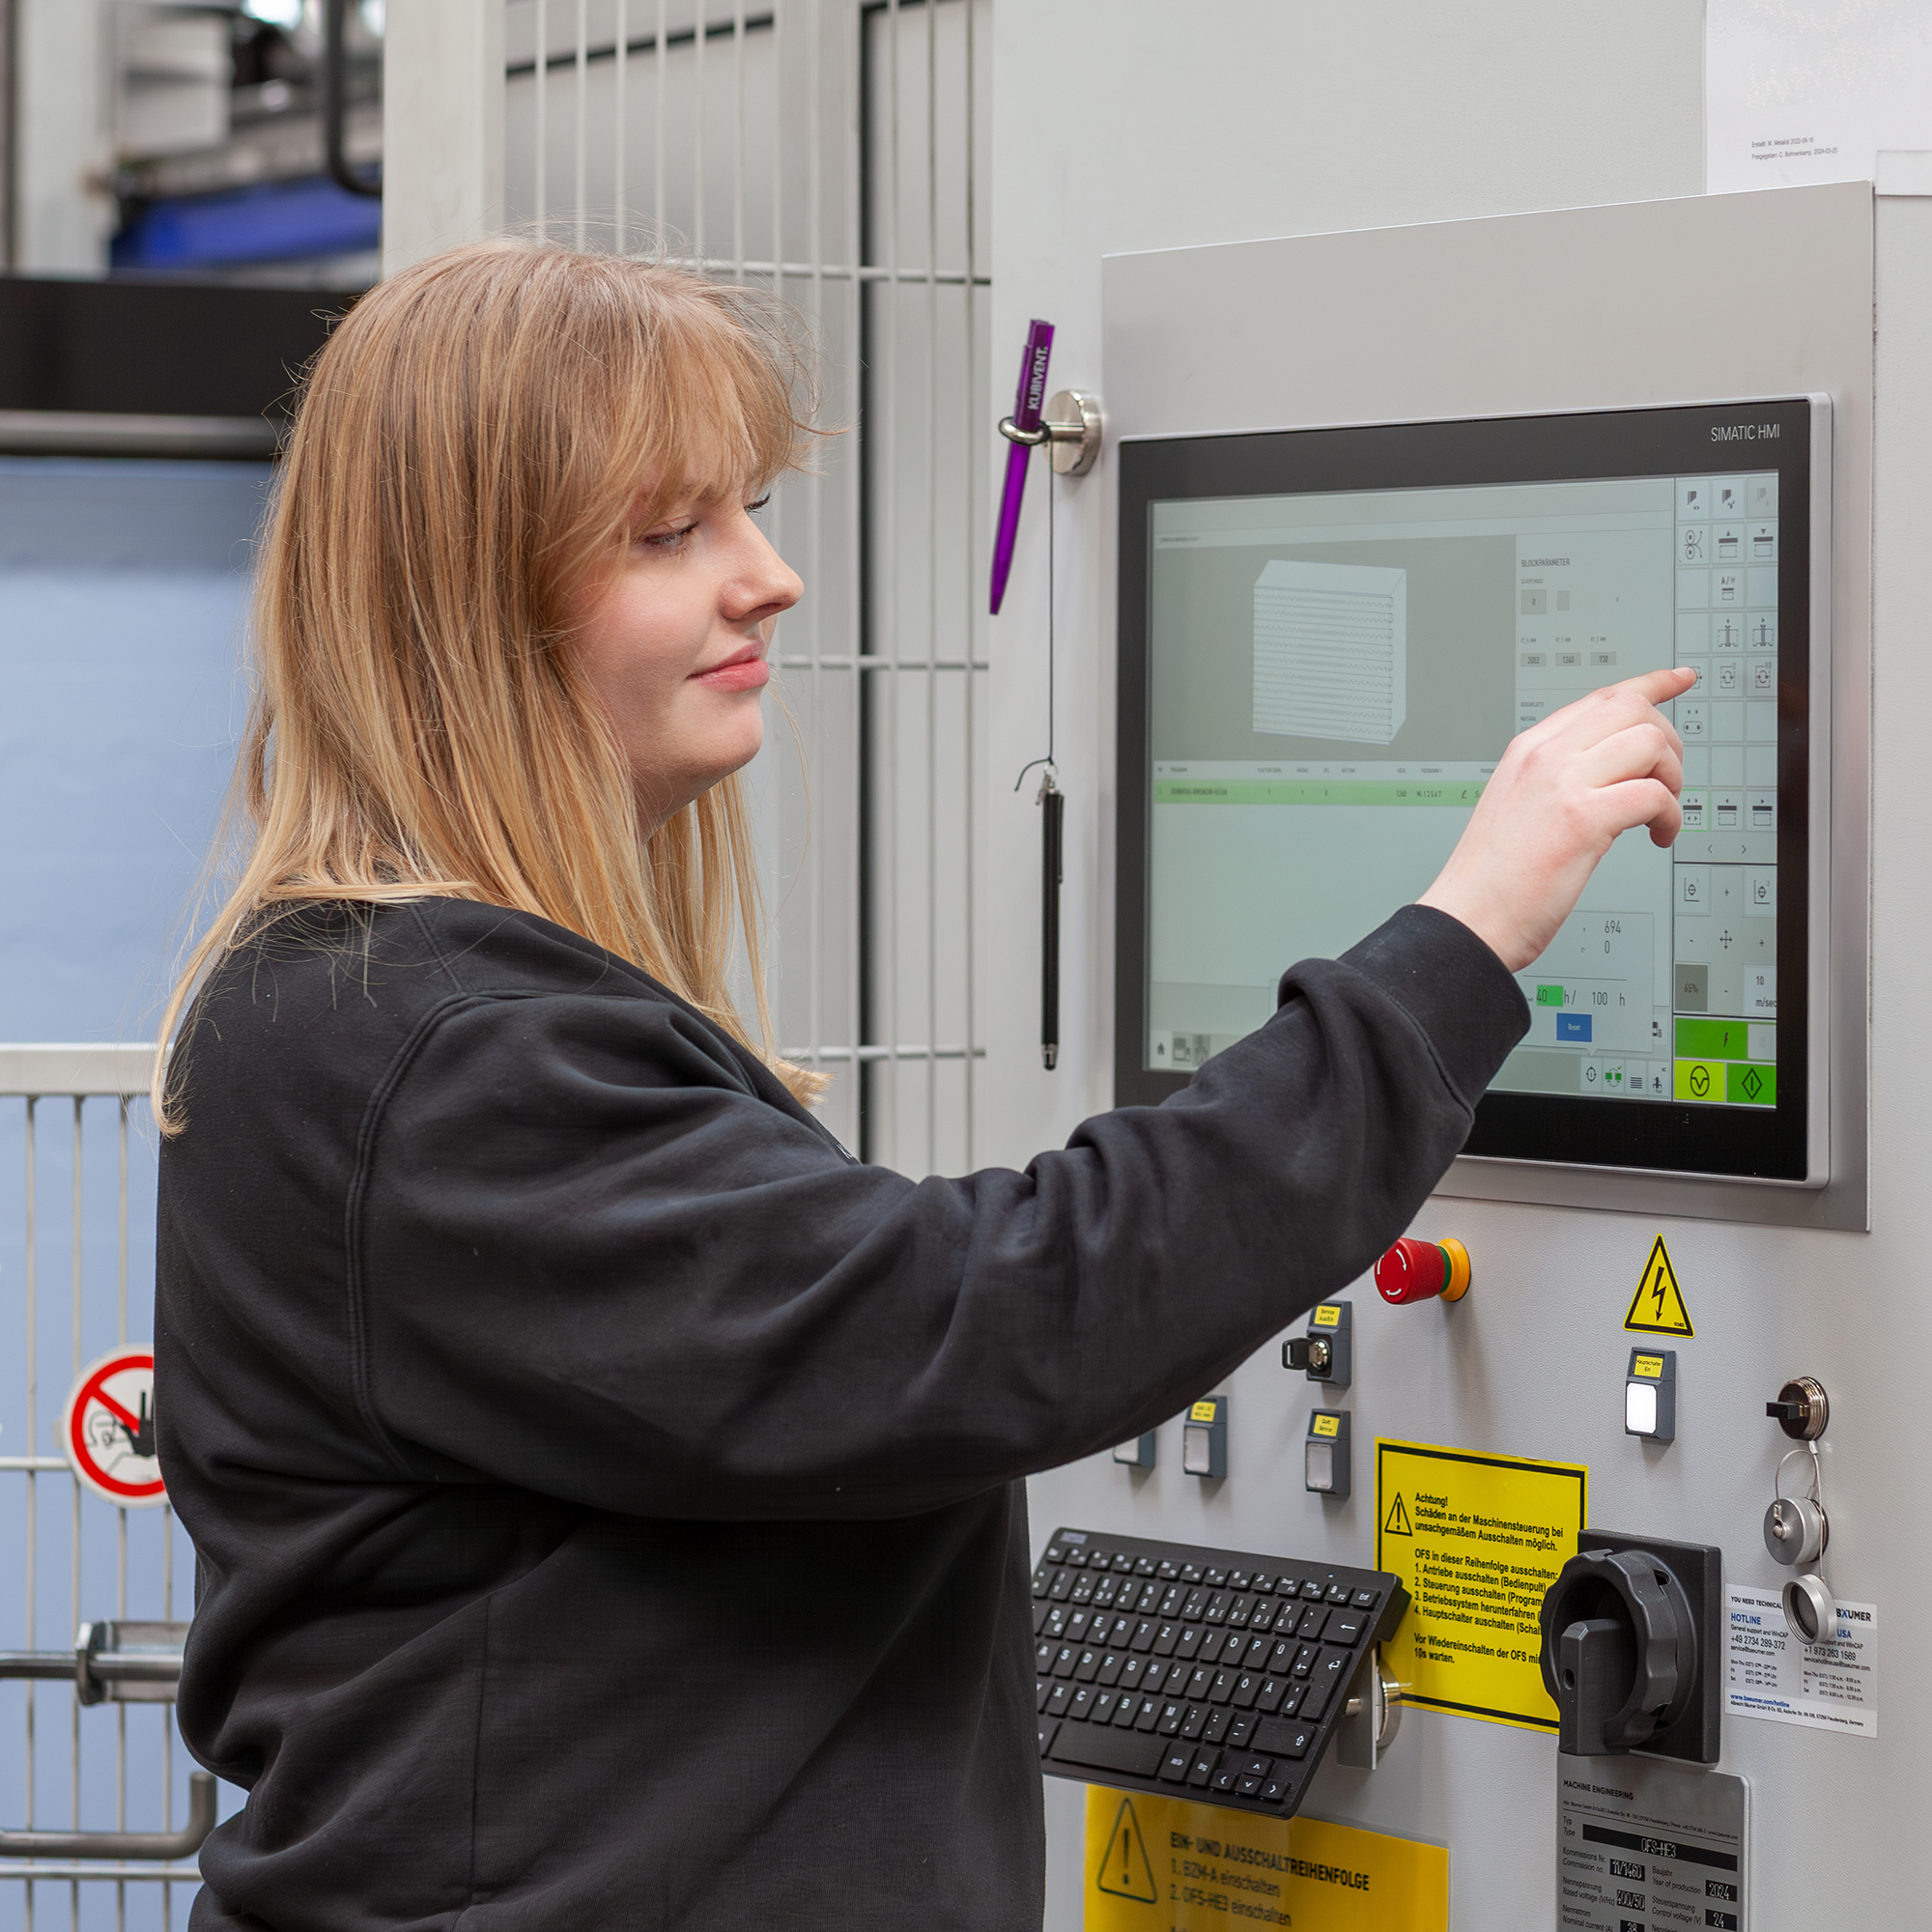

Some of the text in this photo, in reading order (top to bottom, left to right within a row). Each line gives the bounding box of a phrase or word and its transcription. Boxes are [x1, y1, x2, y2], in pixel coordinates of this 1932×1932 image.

[1711, 423, 1780, 442] SIMATIC HMI
[1604, 920, 1621, 934] 694
[1756, 976, 1765, 985] 10
[1592, 991, 1608, 1006] 100
[1415, 1492, 1448, 1508] Achtung!
[1415, 1506, 1563, 1538] Schäden an der Maschinensteuerung bei
[1415, 1522, 1557, 1551] unsachgemäßem Ausschalten möglich.
[1415, 1548, 1558, 1580] OFS in dieser Reihenfolge ausschalten:
[1415, 1562, 1546, 1595] 1. Antriebe ausschalten (Bedienpult)
[1414, 1577, 1421, 1586] 2.
[1423, 1577, 1460, 1595] Steuerung
[1462, 1586, 1506, 1601] ausschalten
[1414, 1591, 1421, 1601] 3.
[1423, 1592, 1479, 1610] Betriebssystem
[1481, 1602, 1535, 1620] herunterfahren
[1756, 1600, 1782, 1609] TECHNICAL
[1414, 1605, 1420, 1615] 4.
[1423, 1606, 1473, 1623] Hauptschalter
[1475, 1617, 1515, 1631] auschalten
[1731, 1613, 1761, 1625] HOTLINE
[1140, 1623, 1149, 1634] T
[1161, 1627, 1171, 1637] Z
[1252, 1640, 1262, 1651] P
[1731, 1634, 1743, 1643] +49
[1744, 1635, 1759, 1646] 2734
[1837, 1629, 1852, 1639] USA
[1414, 1633, 1539, 1663] Vor Wiedereinschalten der OFS mi
[1813, 1647, 1826, 1657] 973
[1429, 1652, 1455, 1663] warten.
[1060, 1649, 1070, 1661] S
[1127, 1660, 1137, 1671] G
[1172, 1667, 1180, 1678] J
[1194, 1671, 1204, 1681] K
[1217, 1675, 1224, 1685] L
[1076, 1690, 1087, 1701] C
[1099, 1694, 1109, 1705] V
[1563, 1779, 1634, 1800] MACHINE ENGINEERING
[1563, 1816, 1573, 1825] Typ
[1563, 1827, 1576, 1836] Type
[1563, 1847, 1597, 1861] Kommissions
[1641, 1837, 1677, 1859] OFS-HE3
[1196, 1837, 1221, 1857] UND
[1224, 1842, 1369, 1891] AUSSCHALTREIHENFOLGE
[1563, 1858, 1595, 1872] Commission
[1652, 1865, 1672, 1877] Baujahr
[1563, 1876, 1602, 1893] Nennspannung
[1653, 1877, 1663, 1887] Year
[1671, 1882, 1701, 1894] production
[1710, 1883, 1729, 1900] 2024
[1563, 1888, 1578, 1897] Rated
[1579, 1891, 1598, 1903] voltage
[1563, 1904, 1591, 1918] Nennstrom
[1652, 1895, 1695, 1914] Steuerspannung
[1563, 1915, 1584, 1927] Nominal
[1585, 1922, 1604, 1931] current
[1652, 1907, 1671, 1918] Control
[1673, 1913, 1692, 1923] voltage
[1714, 1913, 1724, 1928] 24
